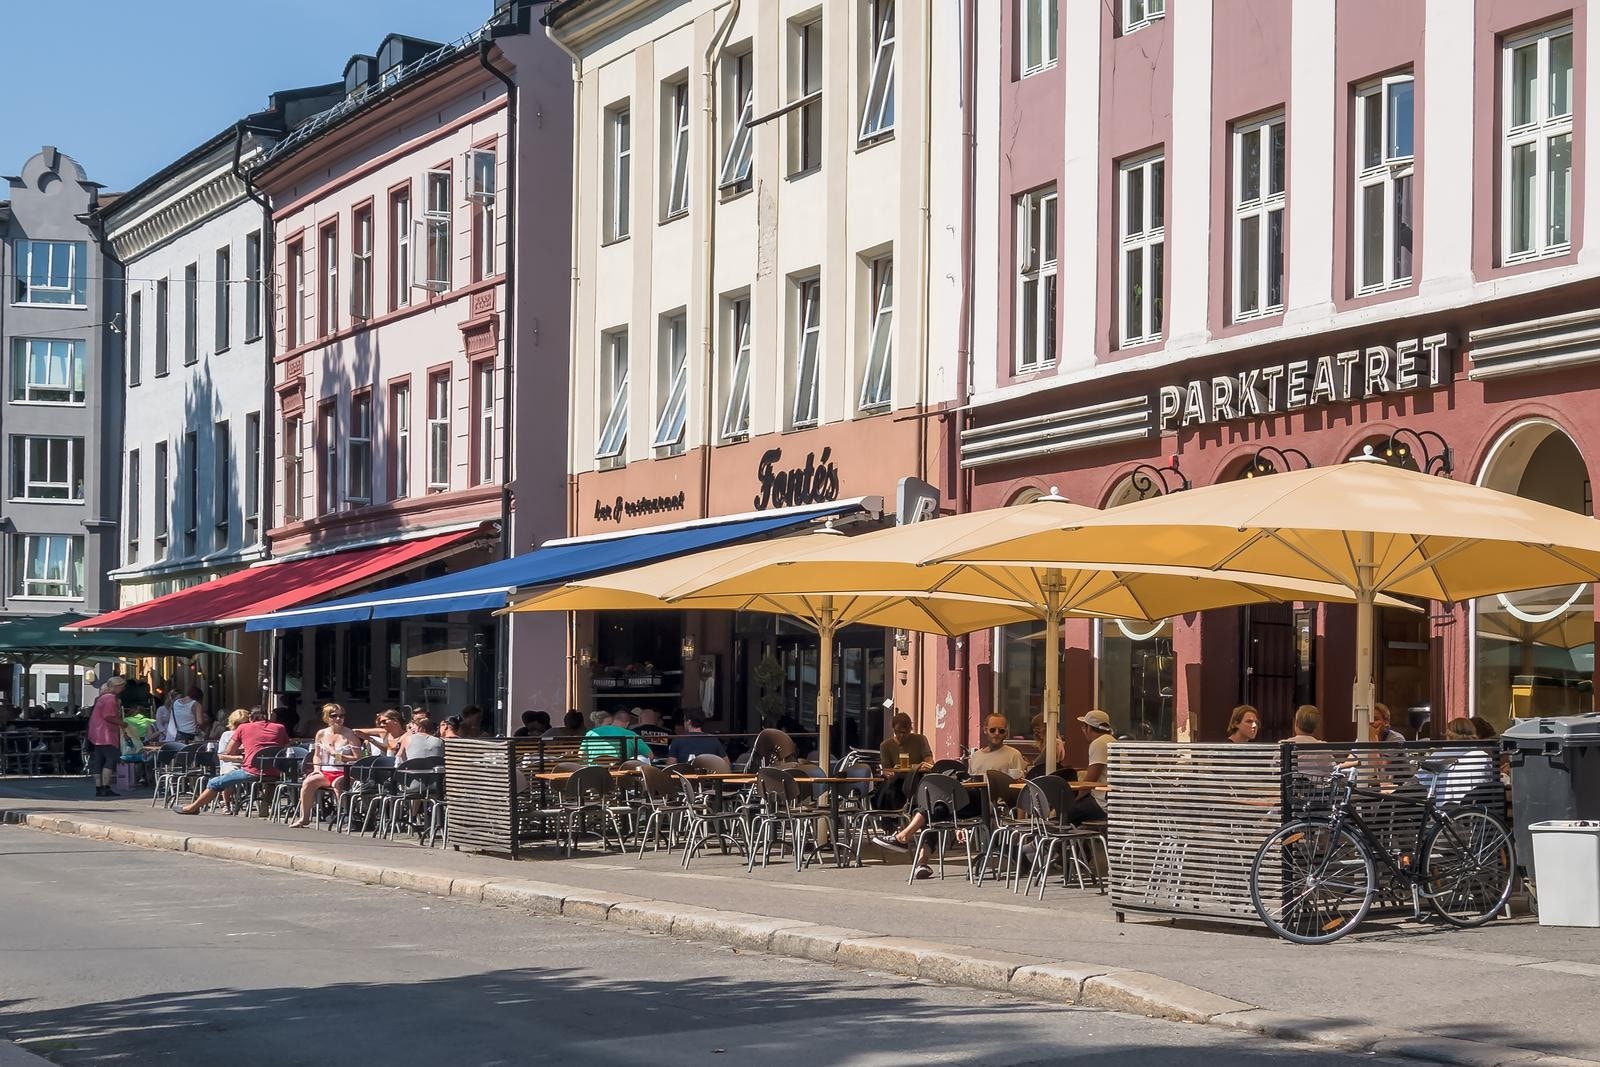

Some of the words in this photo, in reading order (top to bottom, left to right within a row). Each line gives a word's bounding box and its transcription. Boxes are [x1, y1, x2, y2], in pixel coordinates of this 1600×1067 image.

[1160, 332, 1448, 430] PARKTEATRET
[594, 499, 612, 521] bar
[624, 490, 686, 518] restaurant
[754, 446, 839, 511] Fontés
